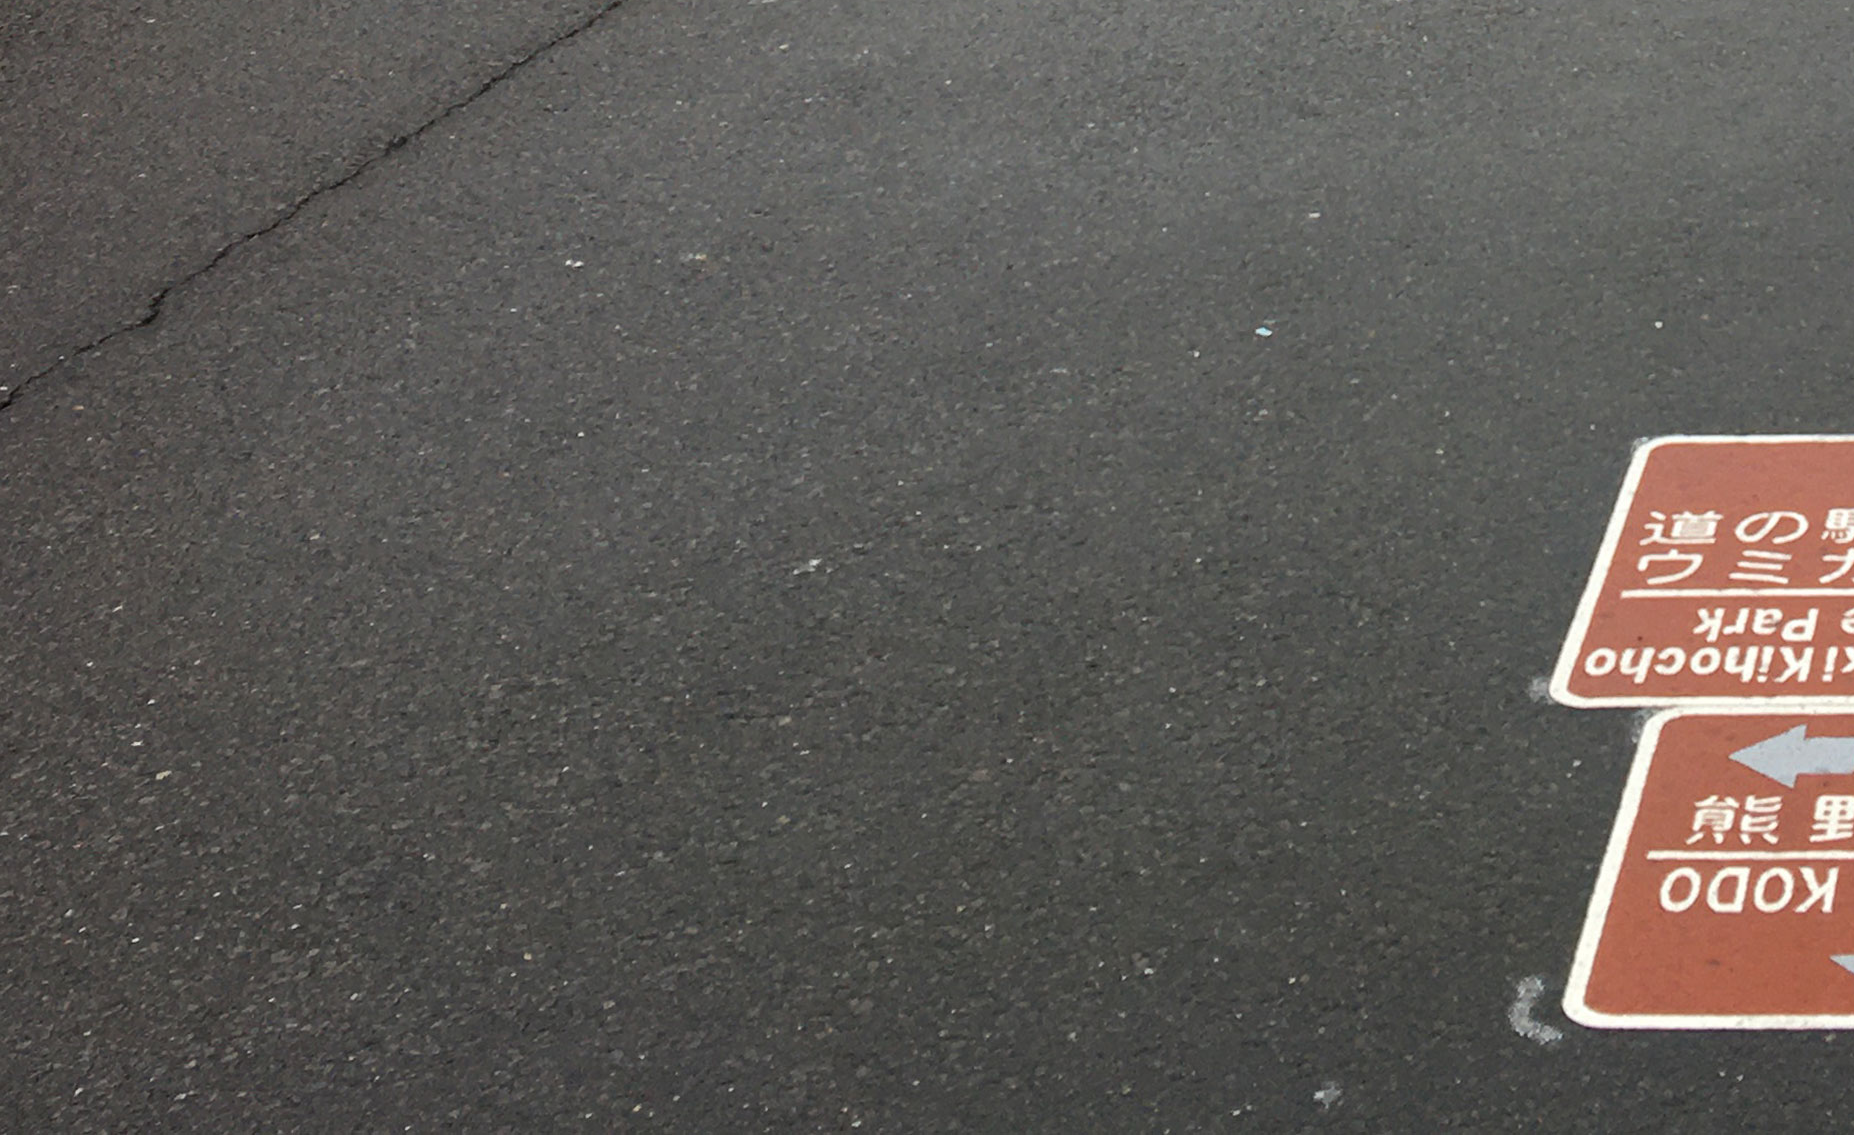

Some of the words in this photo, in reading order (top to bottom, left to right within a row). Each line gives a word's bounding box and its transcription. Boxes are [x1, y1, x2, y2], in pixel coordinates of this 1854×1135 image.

[1692, 606, 1820, 642] Park
[1584, 645, 1813, 683] Kihocho
[1658, 865, 1840, 914] KODO
